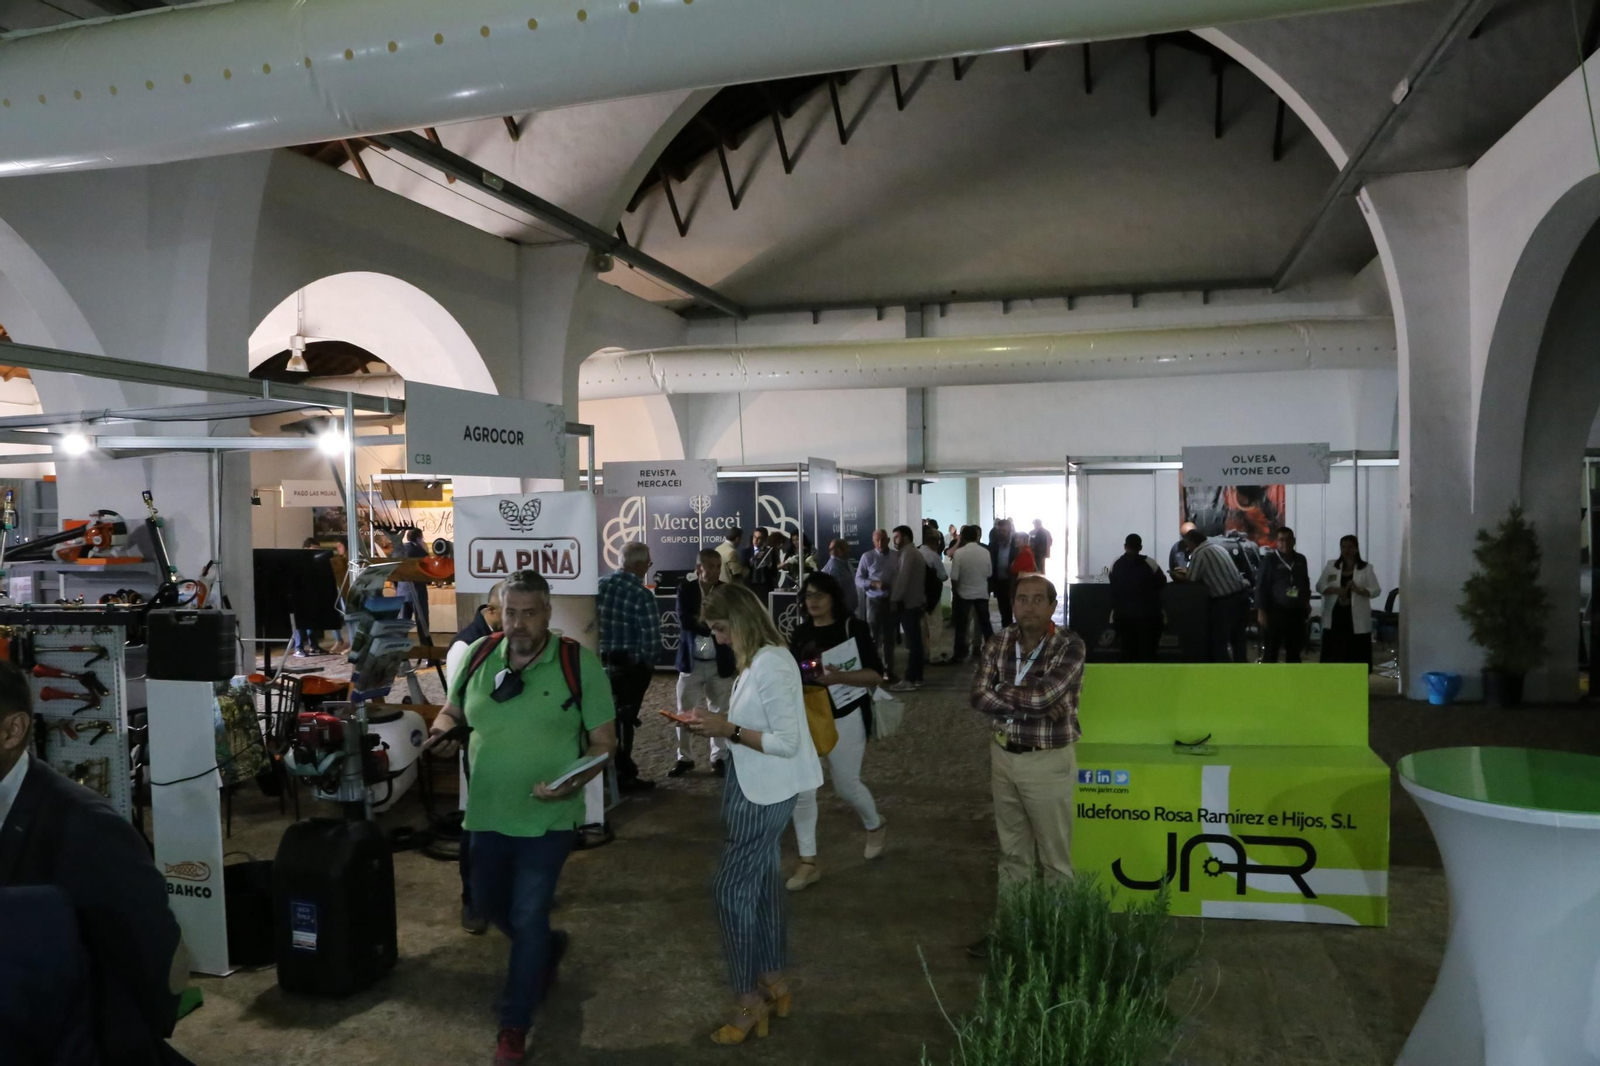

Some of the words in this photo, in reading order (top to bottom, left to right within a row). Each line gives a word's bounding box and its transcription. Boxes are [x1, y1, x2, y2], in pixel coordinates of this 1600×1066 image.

[463, 425, 524, 446] AGROCOR
[414, 454, 432, 465] C3B
[1231, 454, 1277, 464] OLVESA
[639, 469, 677, 477] REVISTA
[1222, 466, 1263, 476] VITONE
[1267, 466, 1290, 475] ECO
[637, 479, 682, 488] MERCACEI
[660, 535, 688, 544] GRUPO
[689, 535, 729, 544] EDITORIA
[476, 549, 509, 574] LA
[516, 543, 575, 574] PIÑA
[1076, 803, 1150, 821] Ildefonso
[1154, 806, 1193, 823] Rosa
[1197, 807, 1264, 826] Ramírez
[1268, 816, 1279, 826] e
[1282, 811, 1327, 832] Hijos,
[1331, 813, 1357, 830] S.L
[167, 882, 212, 899] BAHCO
